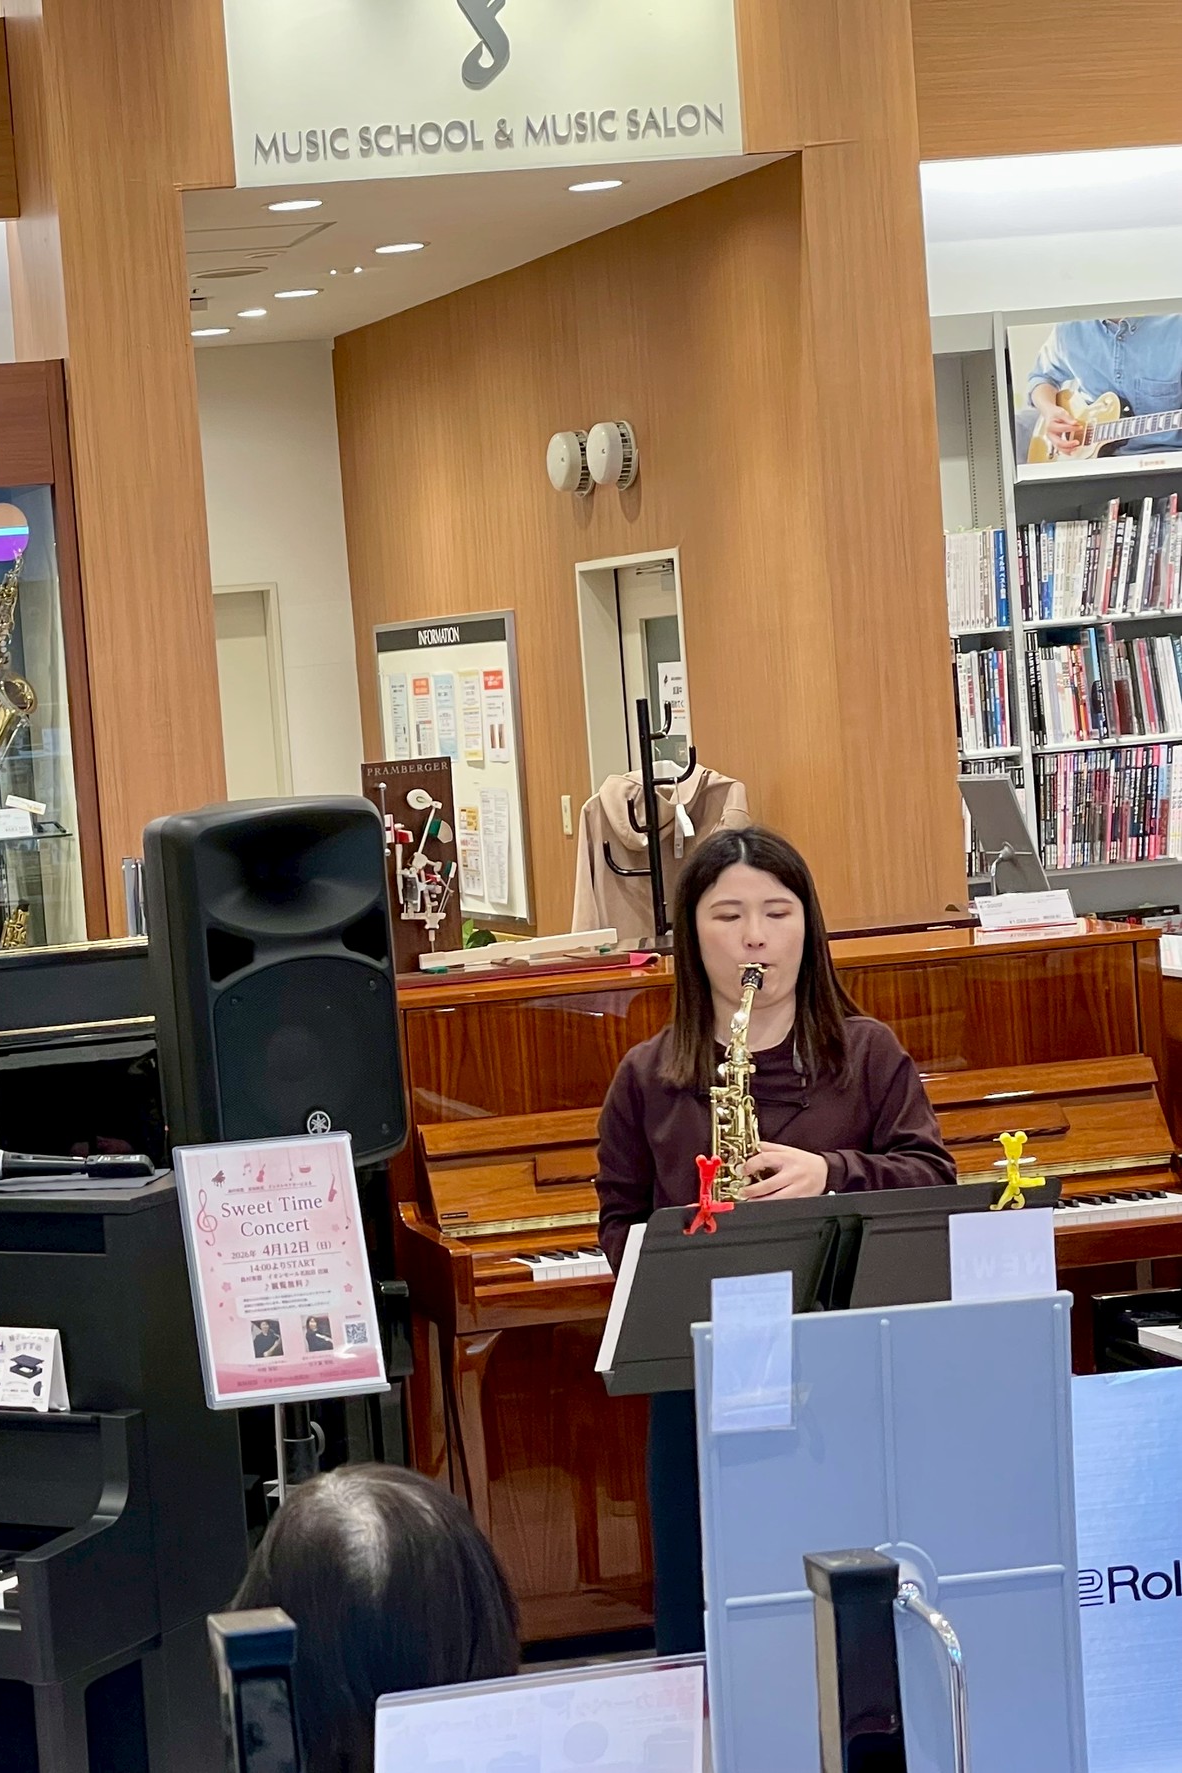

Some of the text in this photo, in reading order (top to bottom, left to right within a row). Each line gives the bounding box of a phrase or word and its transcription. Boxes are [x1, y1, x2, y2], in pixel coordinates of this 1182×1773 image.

[255, 103, 725, 165] MUSIC SCHOOL & MUSIC SALON
[418, 626, 460, 646] INFORMATION
[367, 761, 449, 776] PRAMBERGER
[221, 1196, 323, 1218] Sweet Time
[240, 1218, 310, 1237] Concert
[262, 1241, 309, 1256] 4月12日
[250, 1259, 316, 1273] 14:00よりSTART
